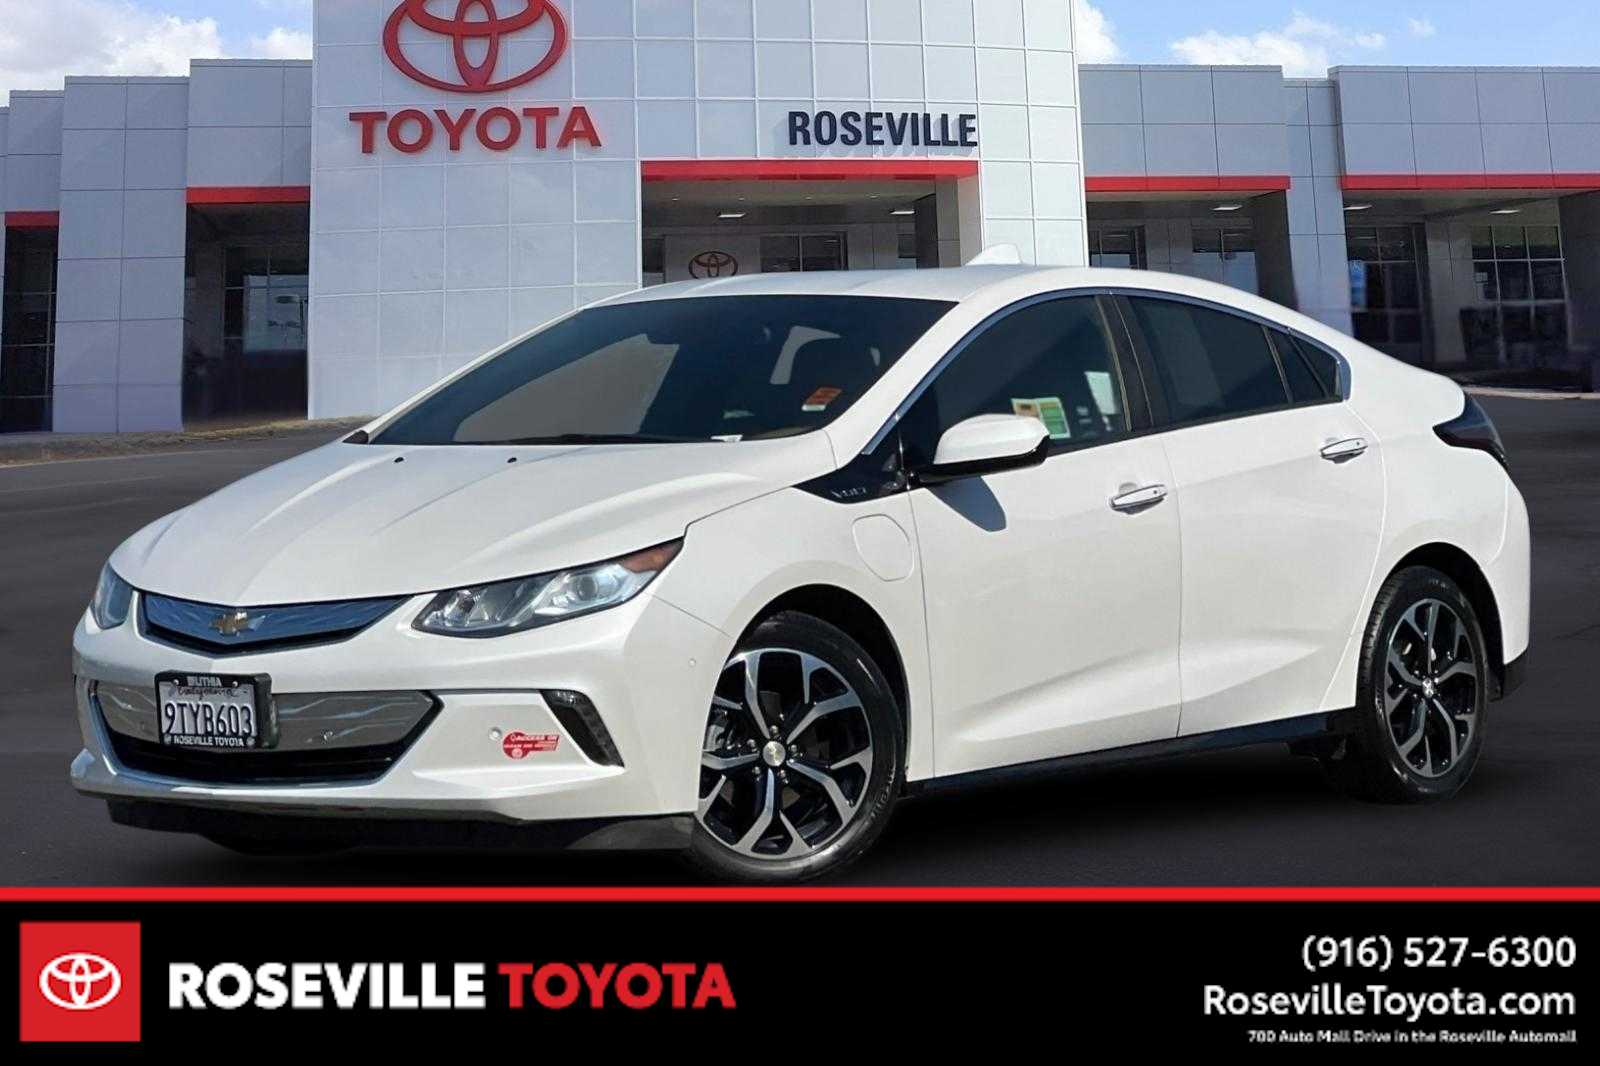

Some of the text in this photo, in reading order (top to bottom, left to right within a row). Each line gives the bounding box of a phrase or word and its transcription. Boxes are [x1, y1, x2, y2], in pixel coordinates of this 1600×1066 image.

[349, 106, 602, 154] TOYOTA
[788, 110, 979, 148] ROSEVILLE
[164, 702, 254, 738] 9TYB603
[173, 735, 245, 747] ROSEVILLE TOYOTA
